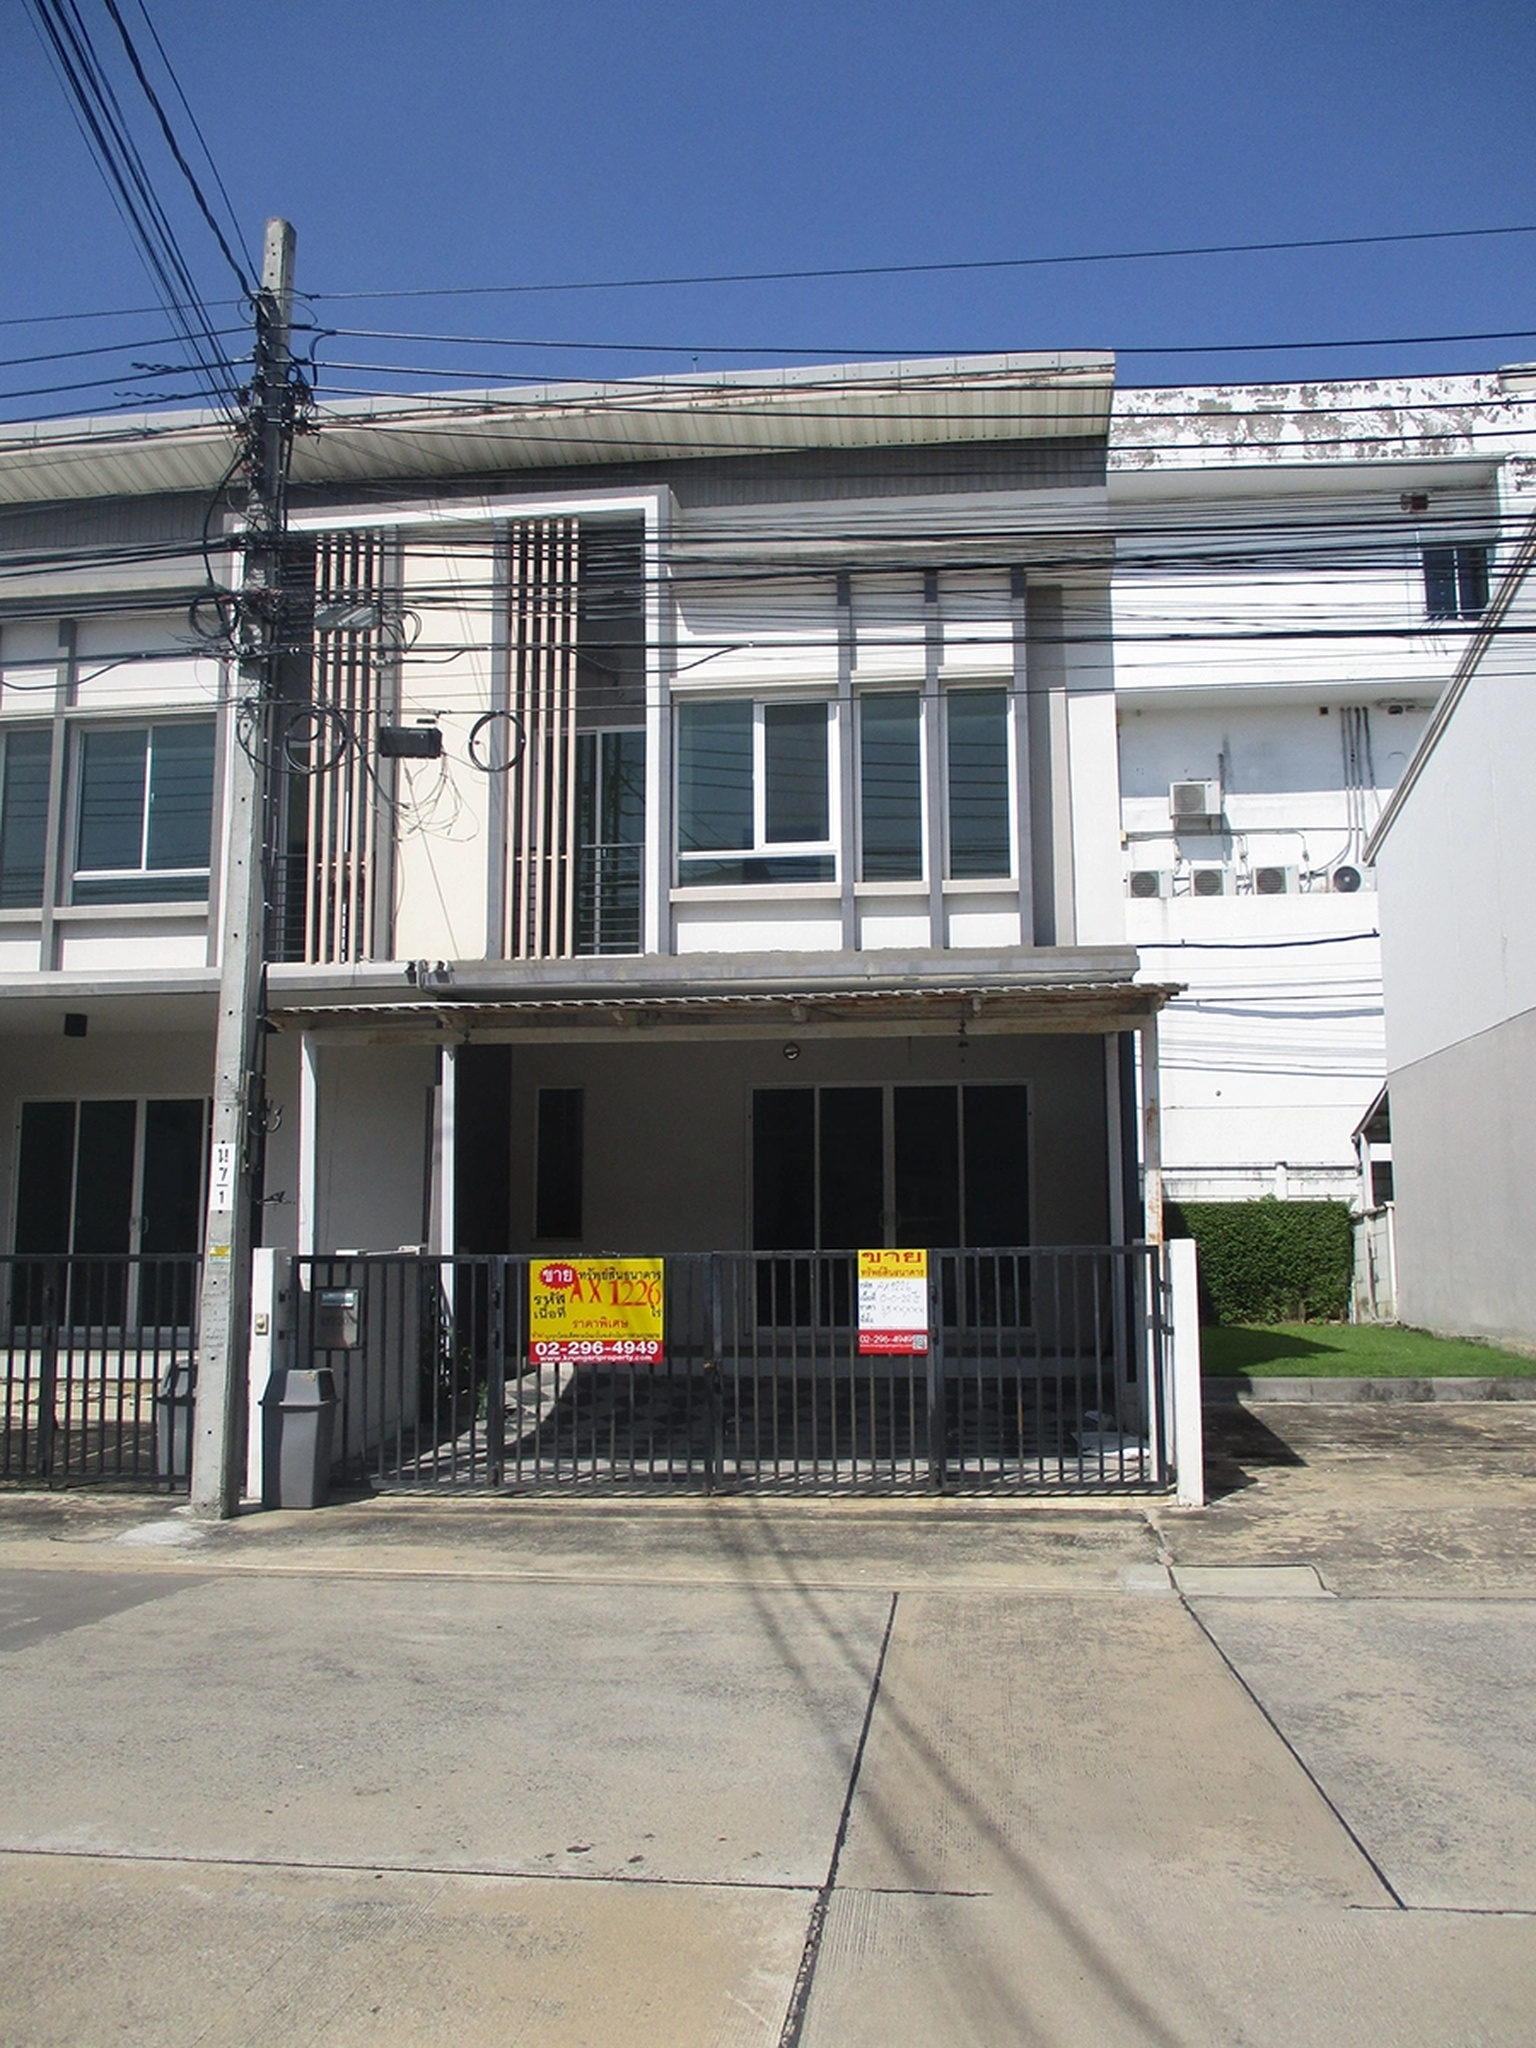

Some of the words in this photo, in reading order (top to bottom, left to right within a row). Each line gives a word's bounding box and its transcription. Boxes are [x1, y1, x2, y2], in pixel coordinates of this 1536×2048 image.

[218, 1167, 229, 1181] 7
[219, 1190, 224, 1203] 1
[861, 1252, 921, 1263] ขาย
[542, 1269, 573, 1282] ขาย
[533, 1291, 567, 1306] รหัส
[535, 1341, 658, 1355] 02-296-4949
